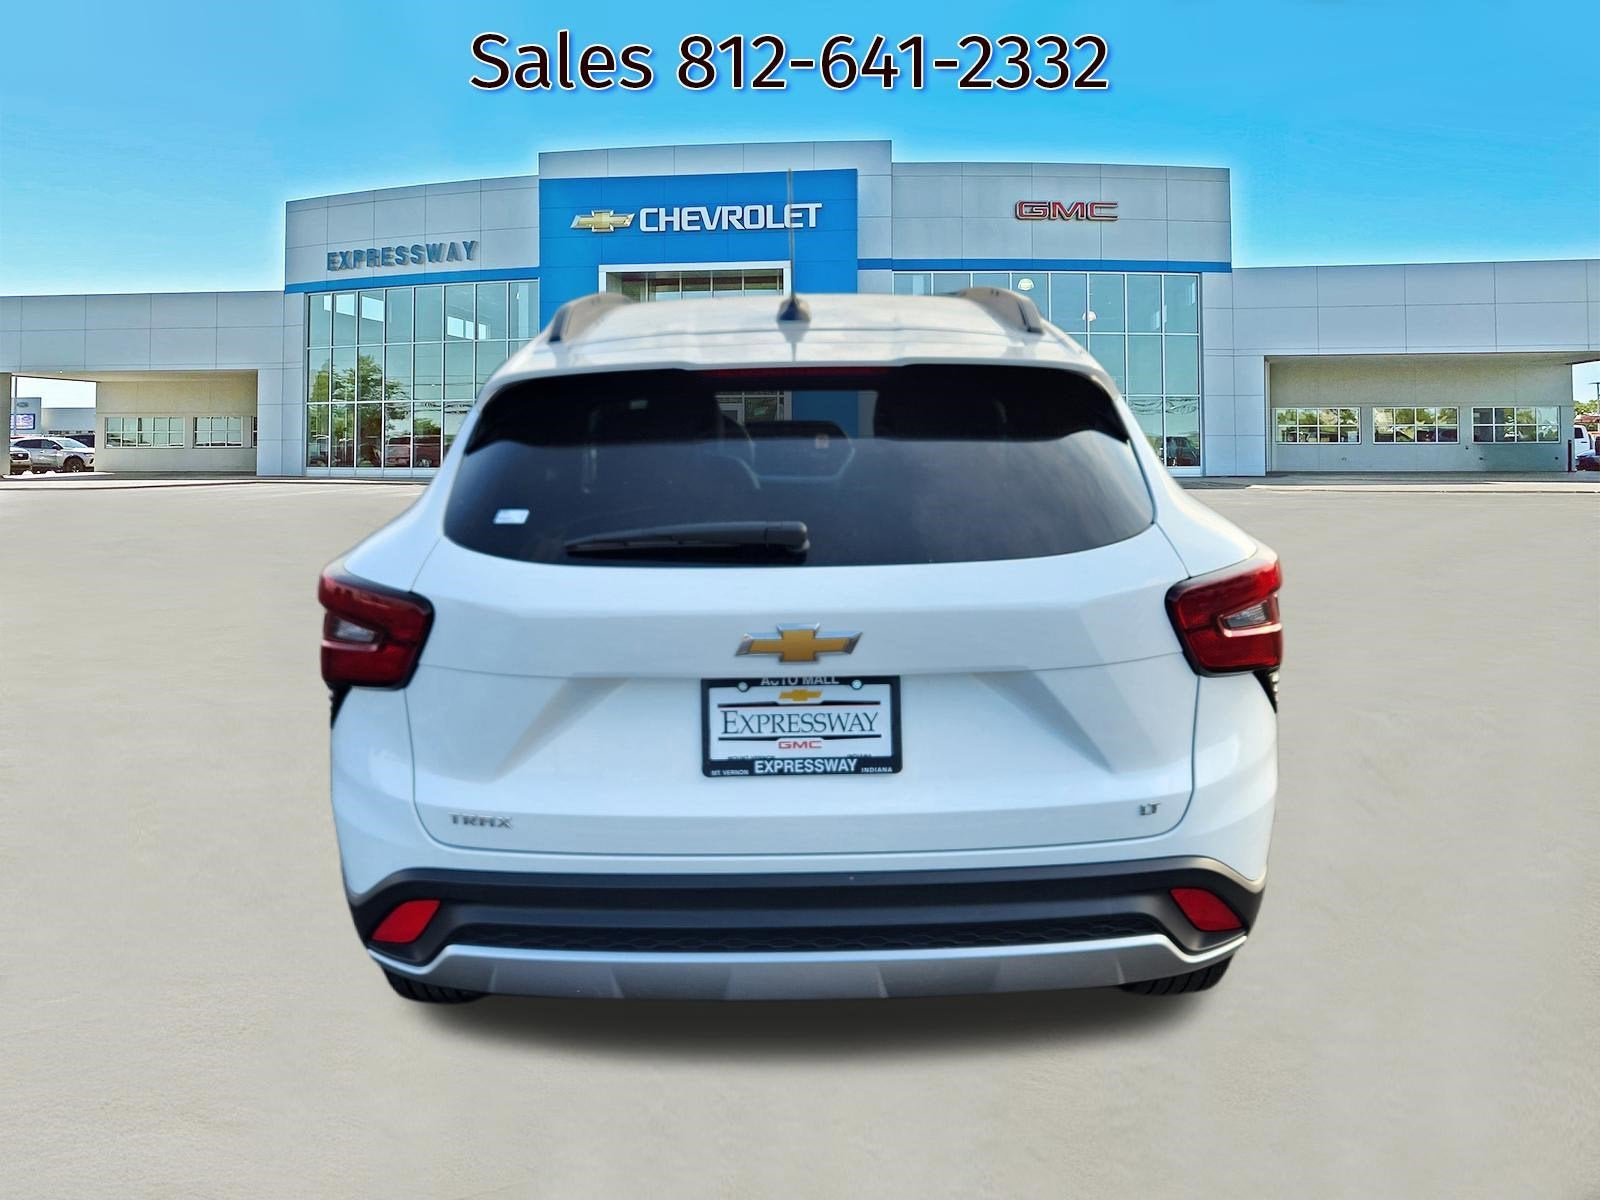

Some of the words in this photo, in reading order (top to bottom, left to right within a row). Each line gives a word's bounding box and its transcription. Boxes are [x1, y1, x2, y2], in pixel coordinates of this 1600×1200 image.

[639, 203, 823, 232] CHEVROLET
[1015, 200, 1119, 221] GMC
[326, 240, 478, 271] EXPRESSWAY
[720, 709, 879, 735] EXPRESSWAY
[778, 740, 822, 749] GMC
[754, 759, 858, 774] EXPRESSWAY
[1139, 802, 1161, 816] LT
